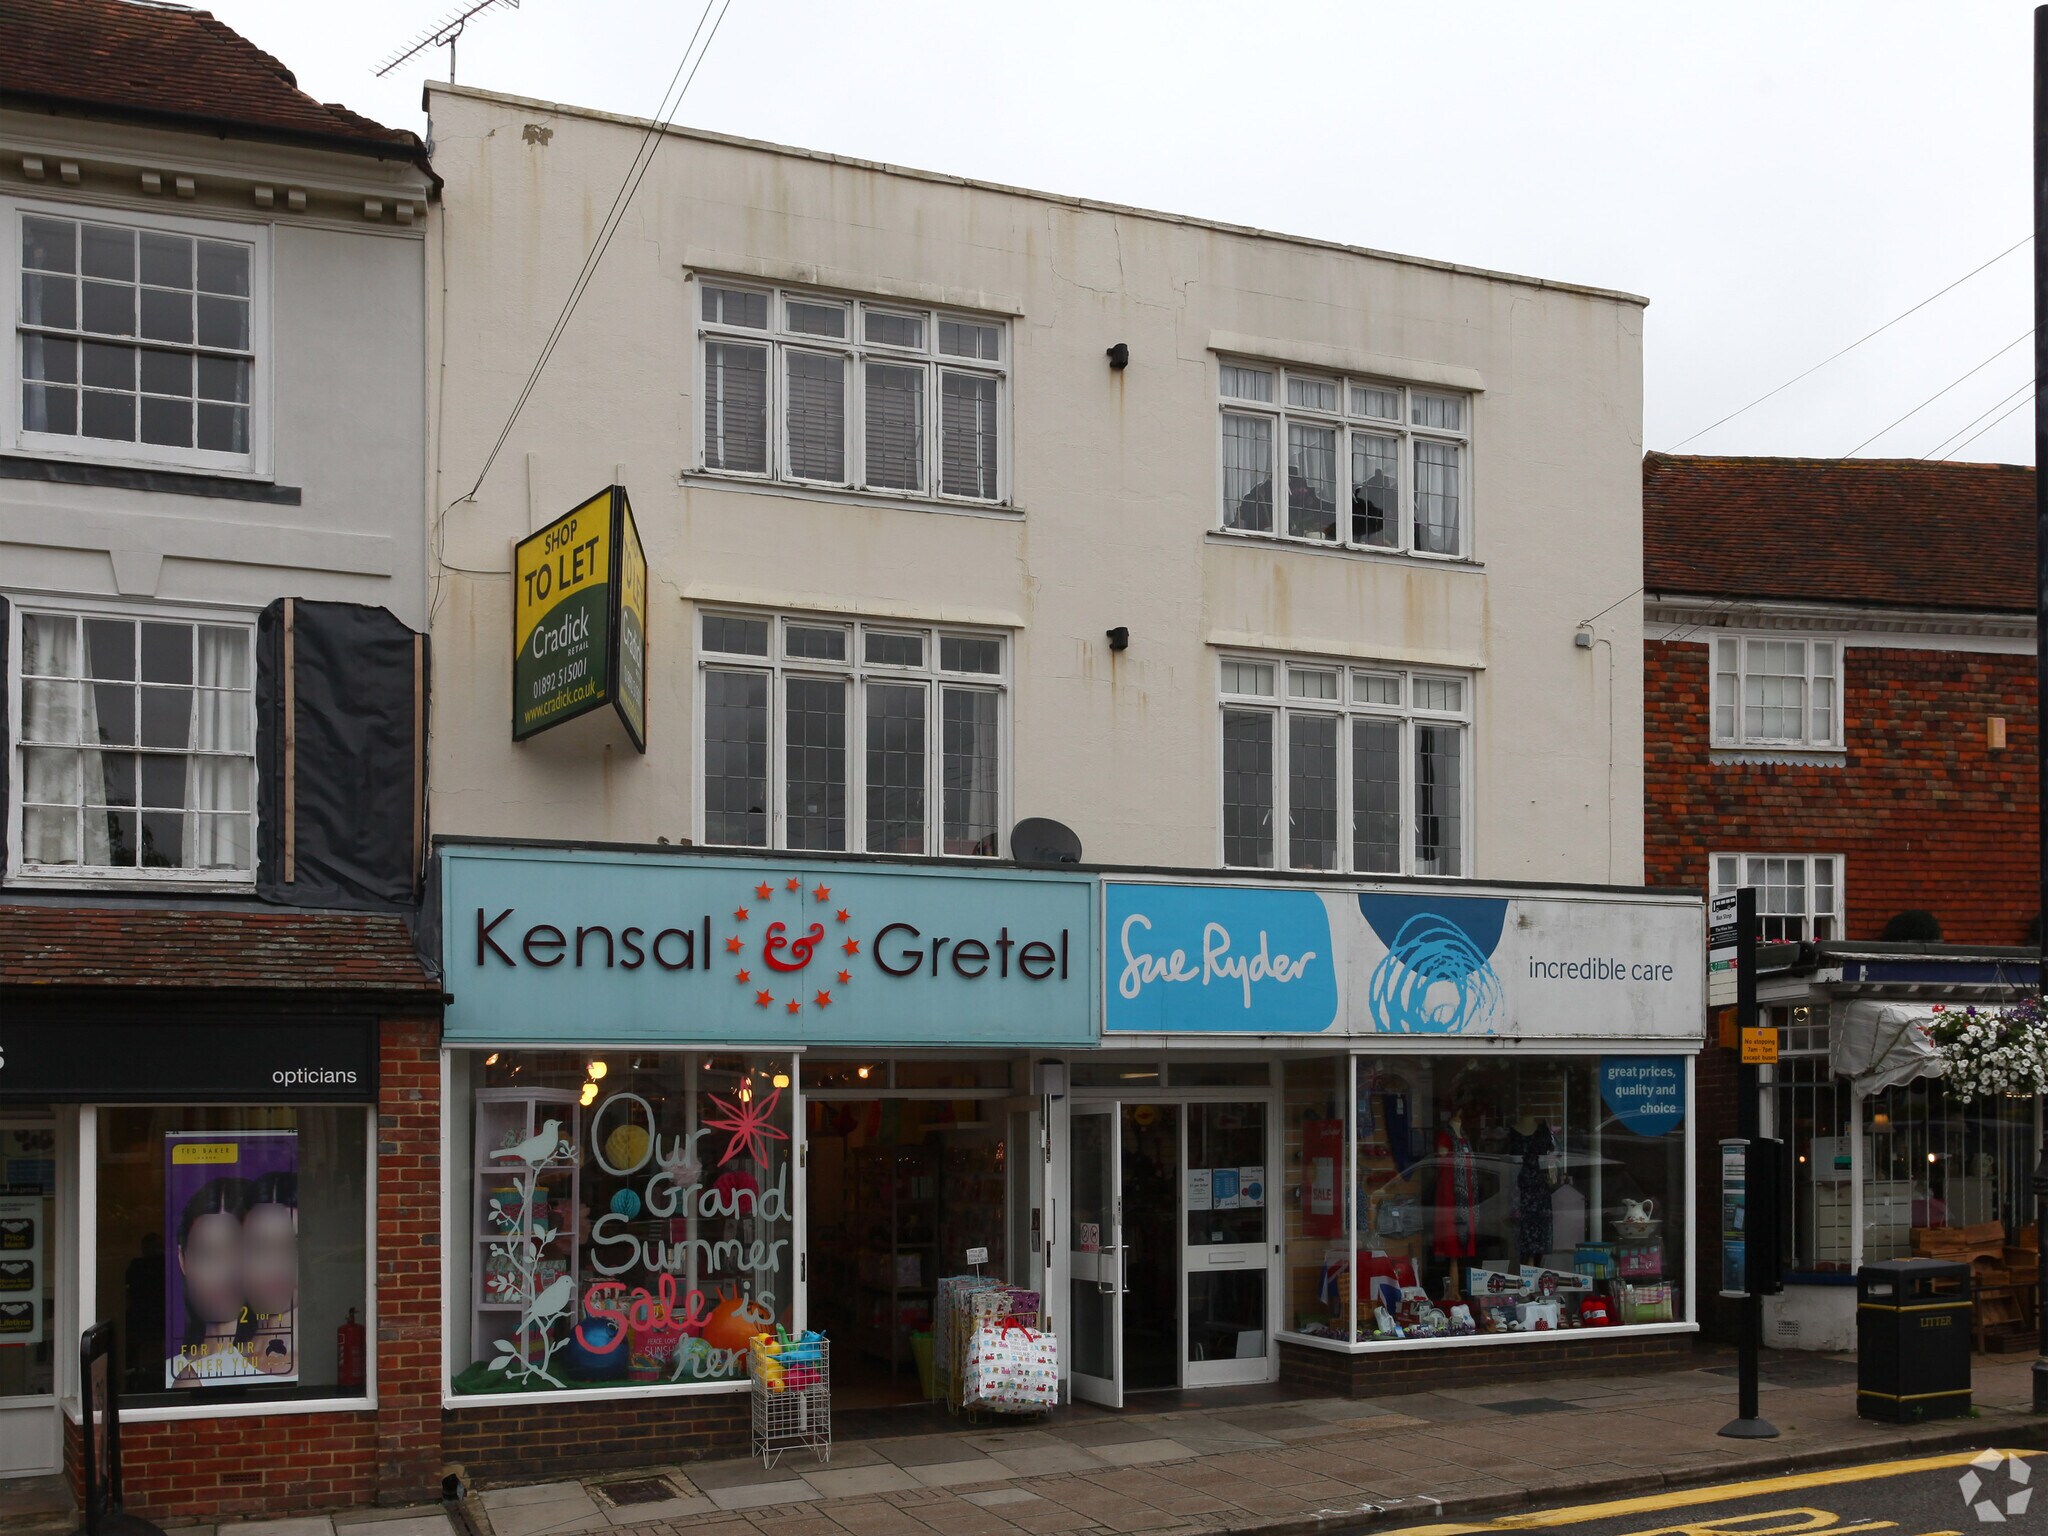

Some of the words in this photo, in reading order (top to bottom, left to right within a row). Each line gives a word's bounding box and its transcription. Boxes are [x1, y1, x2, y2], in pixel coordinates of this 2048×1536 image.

[544, 519, 577, 555] SHOP
[524, 563, 552, 607] TO
[559, 535, 599, 591] LET
[532, 606, 589, 659] Cradick
[567, 641, 589, 657] RETAIL
[533, 677, 556, 699] 01892
[558, 657, 587, 687] 515001
[525, 677, 596, 723] www.cradick.co.uk
[475, 907, 711, 970] Kensal
[763, 921, 825, 972] &
[873, 922, 1069, 980] Gretel
[1119, 913, 1200, 999] Sue
[1202, 922, 1317, 1008] Ryder
[1529, 955, 1626, 981] incredible
[1631, 963, 1673, 981] care
[272, 1067, 358, 1087] opticians
[1608, 1066, 1638, 1080] great
[1640, 1065, 1676, 1079] prices,
[1615, 1084, 1654, 1098] quality
[1655, 1084, 1676, 1095] and
[1640, 1102, 1676, 1113] choice
[590, 1092, 712, 1176] Our
[645, 1161, 792, 1222] Grand
[1313, 1189, 1332, 1200] SALE
[590, 1212, 789, 1276] Summer
[240, 1306, 249, 1324] 2
[575, 1272, 713, 1354] Sale
[731, 1281, 776, 1325] is
[1920, 1315, 1952, 1328] LITTER
[176, 1358, 224, 1374] OTHER
[232, 1356, 259, 1370] YOU
[181, 1344, 208, 1357] FOR
[217, 1341, 254, 1355] YOUR
[671, 1332, 752, 1382] her
